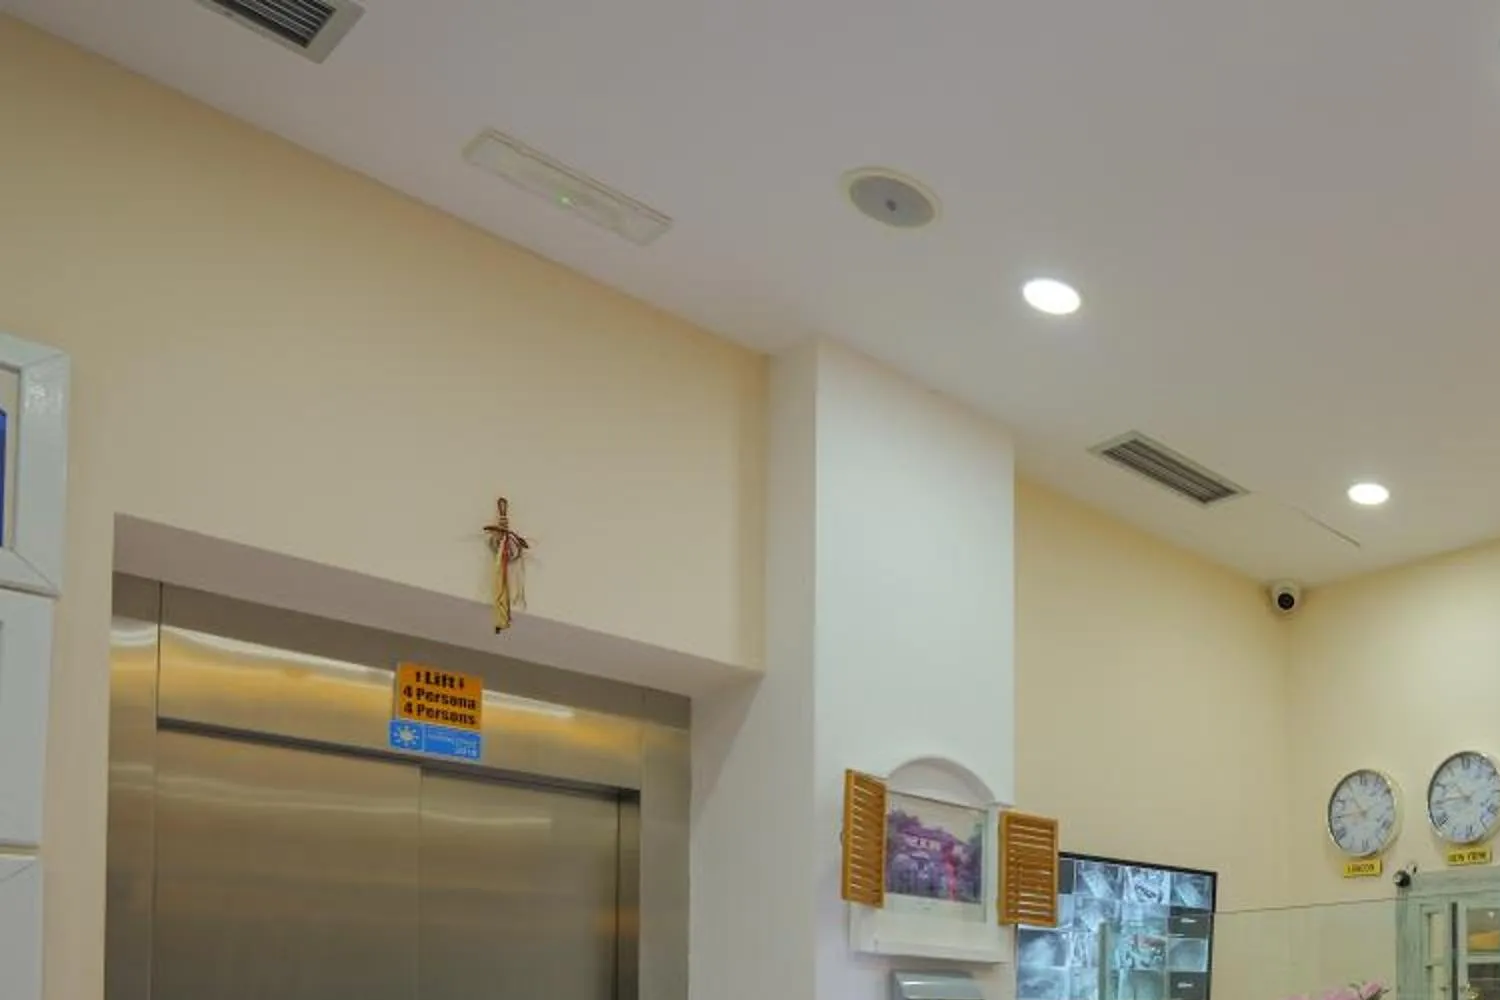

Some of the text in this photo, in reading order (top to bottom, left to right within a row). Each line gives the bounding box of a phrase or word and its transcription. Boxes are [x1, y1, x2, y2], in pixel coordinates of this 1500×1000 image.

[425, 671, 455, 688] Lift
[403, 685, 476, 710] 4 Persona
[403, 701, 413, 714] 4
